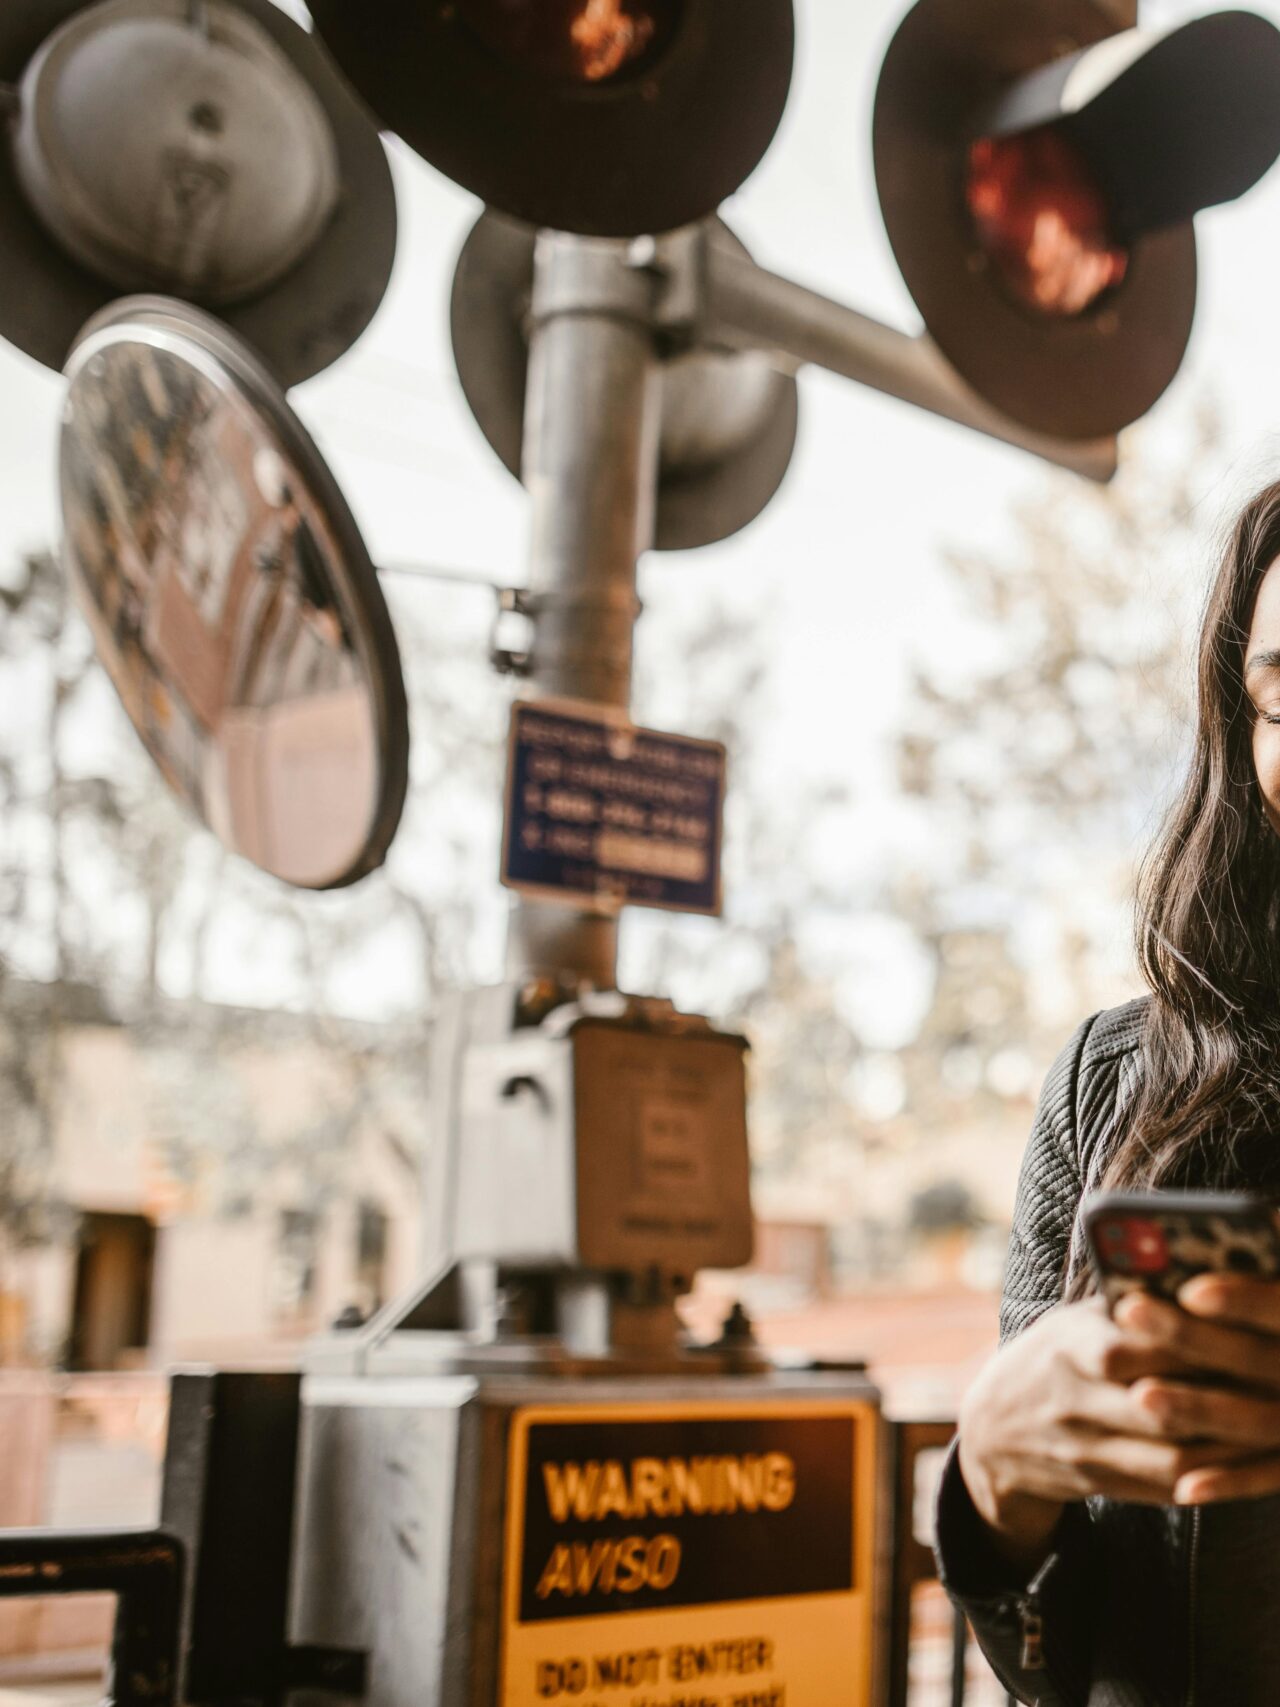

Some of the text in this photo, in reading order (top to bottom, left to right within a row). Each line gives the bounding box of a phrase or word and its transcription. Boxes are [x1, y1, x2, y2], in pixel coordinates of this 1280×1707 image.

[542, 1451, 797, 1523] WARNING
[536, 1533, 681, 1599] AVISO
[536, 1656, 588, 1698] DO
[592, 1647, 661, 1691] NOT
[667, 1636, 774, 1683] ENTER
